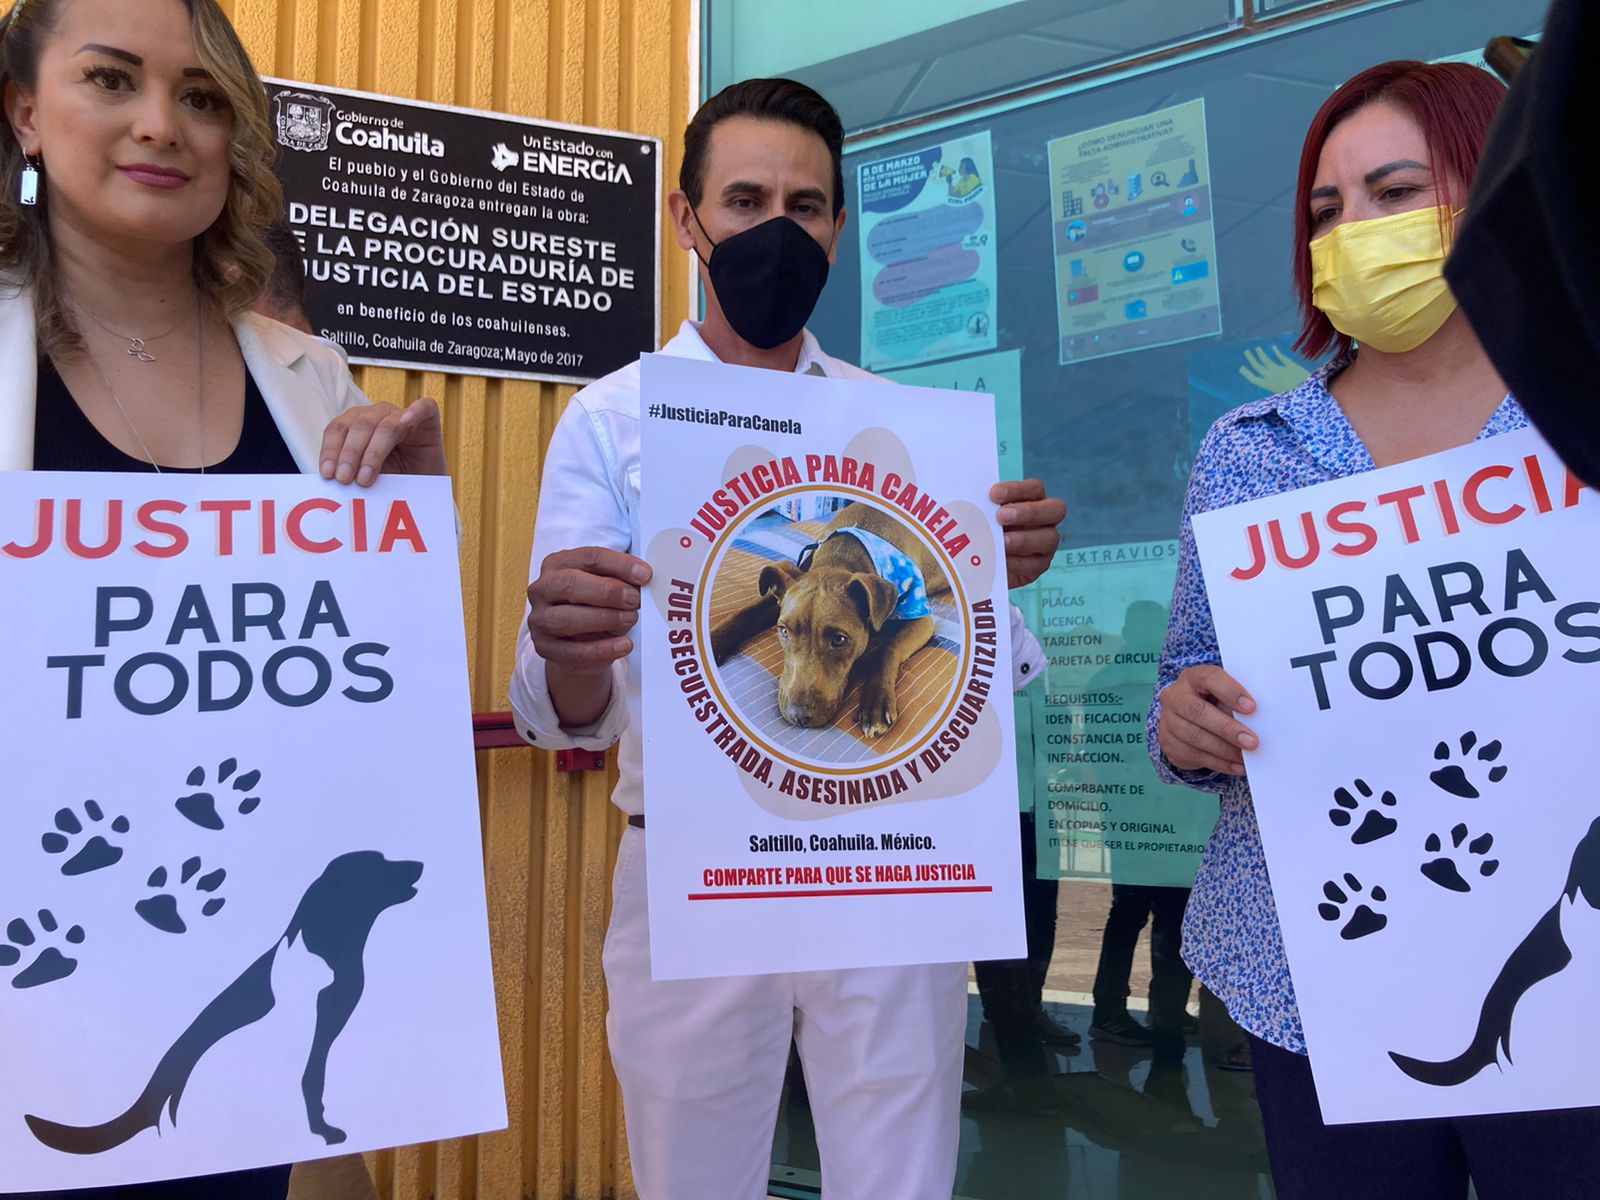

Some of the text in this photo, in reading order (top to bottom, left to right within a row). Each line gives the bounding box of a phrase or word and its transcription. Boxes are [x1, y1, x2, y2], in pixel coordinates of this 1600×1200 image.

[336, 110, 404, 129] Gobierno de
[1107, 121, 1154, 142] DENUNCIAR
[1155, 118, 1173, 130] UNA
[335, 121, 445, 157] Coahuila
[523, 134, 613, 160] Un Estado con
[1078, 147, 1101, 158] FALTA
[1103, 127, 1173, 151] ADMINISTRATIVA?
[872, 164, 884, 175] DE
[886, 156, 920, 172] MARZO
[329, 156, 585, 203] El pueblo y el Gobierno del Estado de
[863, 170, 928, 192] DE LA MUJER
[322, 176, 589, 224] Coahuila de Zaragoza entregan la obra:
[289, 202, 616, 262] DELEGACIÓN SURESTE
[317, 233, 356, 257] LA
[365, 238, 594, 285] PROCURADURÍA
[601, 266, 634, 289] DE
[438, 273, 494, 299] DEL
[502, 280, 612, 312] ESTADO
[337, 302, 570, 338] en beneficio de los coahuilenses.
[321, 329, 369, 349] Saltillo,
[373, 333, 426, 352] Coahuila
[430, 340, 444, 354] de
[540, 350, 554, 364] de
[556, 352, 584, 367] 2017
[648, 403, 802, 435] #JusticiaParaCanela
[690, 454, 971, 559] JUSTICIA PARA CANELA
[1, 497, 428, 560] JUSTICIA
[1066, 543, 1176, 565] EXTRAVIOS
[1042, 596, 1085, 608] PLACAS
[1311, 548, 1557, 645] PARA
[94, 580, 350, 647] PARA
[1043, 616, 1094, 627] LICENCIA
[1044, 635, 1102, 647] TARJETON
[1047, 655, 1093, 667] ARJETA
[1096, 655, 1112, 665] DE
[1290, 601, 1600, 711] TODOS
[46, 642, 394, 720] TODOS
[667, 578, 997, 806] FUE SECUESTRADA, ASESINADA Y DESCUARTIZADA
[1045, 712, 1141, 725] IDENTIFICACION
[1047, 733, 1143, 745] CONSTANCIA DE
[1048, 752, 1124, 764] INFRACCION.
[1048, 782, 1144, 795] COMPRBANTE DE
[1048, 801, 1112, 812] DOMICILIO.
[1049, 820, 1176, 834] EN COPIAS Y ORIGINAL
[749, 832, 936, 854] Saltillo, Coahuila. México.
[1049, 838, 1205, 854] (TIENE QUE SER EL PROPIETARIO
[703, 863, 976, 887] COMPARTE PARA QUE SE HAGA JUSTICIA
